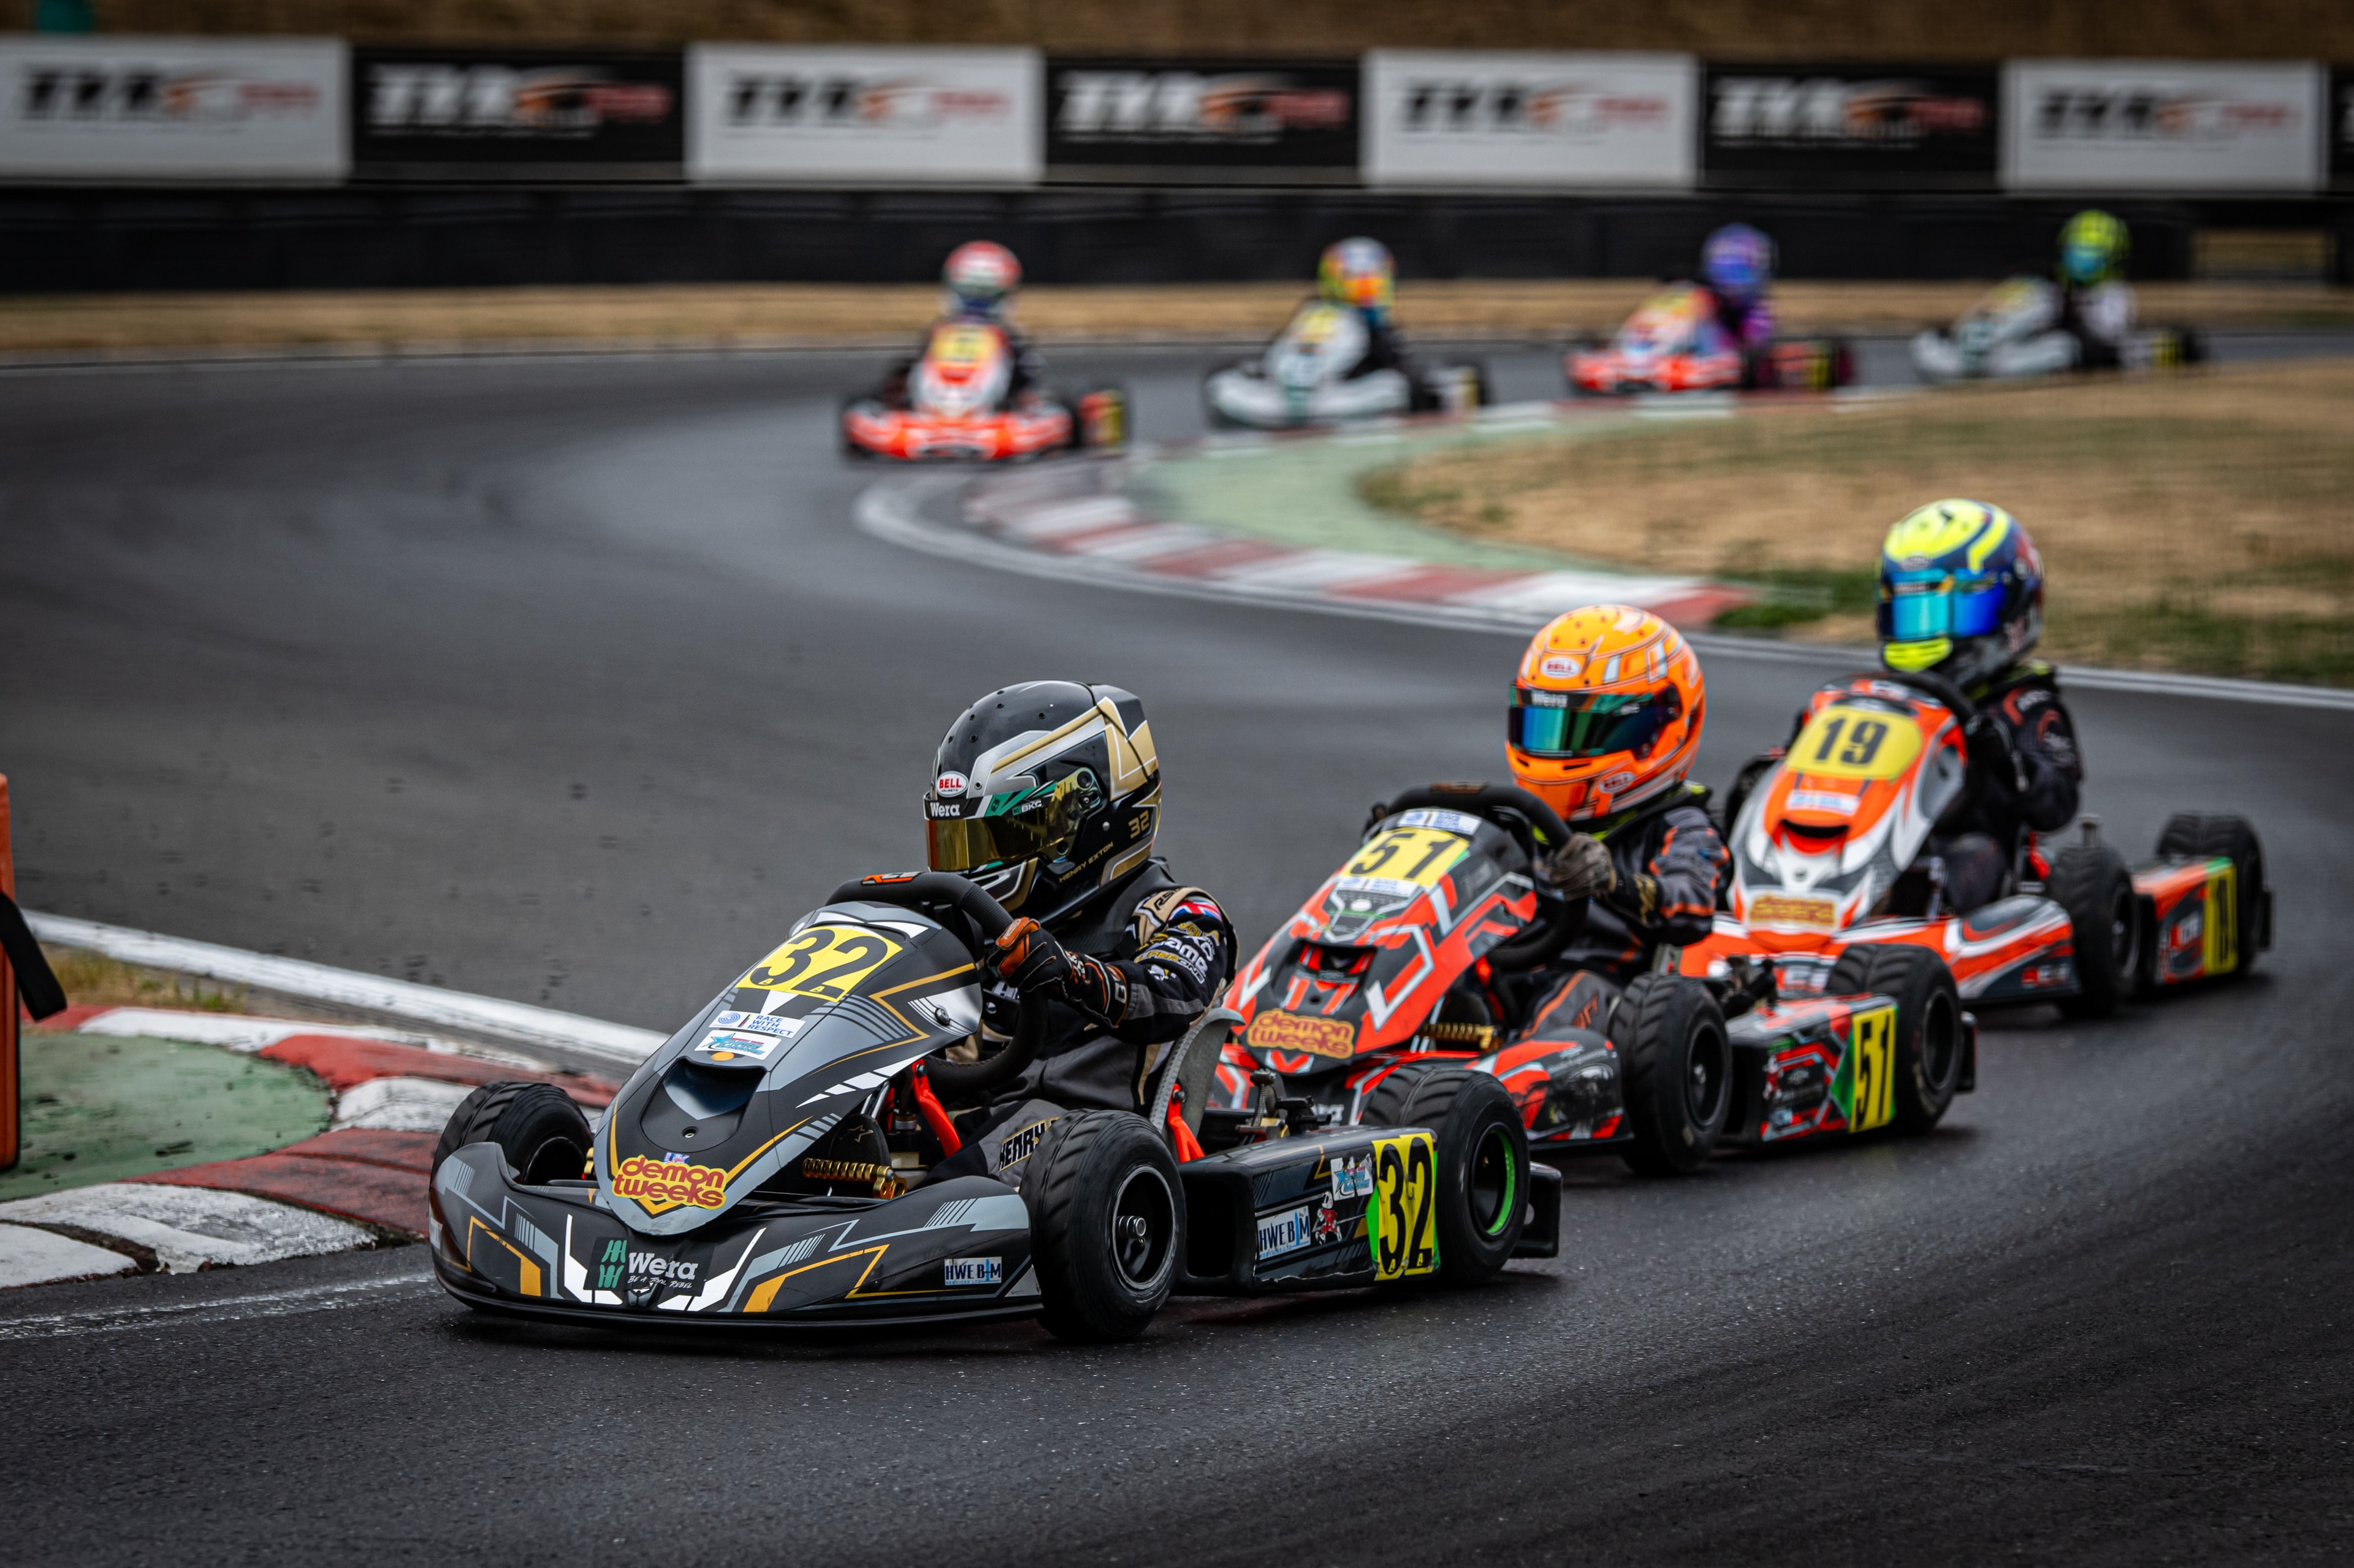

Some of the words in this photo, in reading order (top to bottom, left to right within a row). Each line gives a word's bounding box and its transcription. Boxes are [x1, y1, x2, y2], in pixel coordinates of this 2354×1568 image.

[1815, 717, 1889, 766] 19
[939, 778, 962, 789] BELL
[930, 802, 960, 817] Wera
[1128, 810, 1150, 839] 32
[1059, 861, 1087, 883] HENRY
[1088, 840, 1114, 864] EXTON
[1350, 832, 1455, 880] 51
[750, 929, 888, 998] 32
[747, 1024, 794, 1036] RESPECT
[752, 1019, 780, 1028] WITH
[1259, 1013, 1350, 1038] demon
[1251, 1027, 1349, 1054] tweeks
[1856, 1014, 1890, 1131] 51
[622, 1157, 725, 1189] demon
[614, 1174, 723, 1207] tweeks
[1379, 1137, 1433, 1275] 32
[1259, 1223, 1286, 1251] HWE
[627, 1275, 640, 1284] BE
[650, 1277, 667, 1285] TOOL
[628, 1252, 698, 1280] Wera
[946, 1264, 974, 1280] HWE
